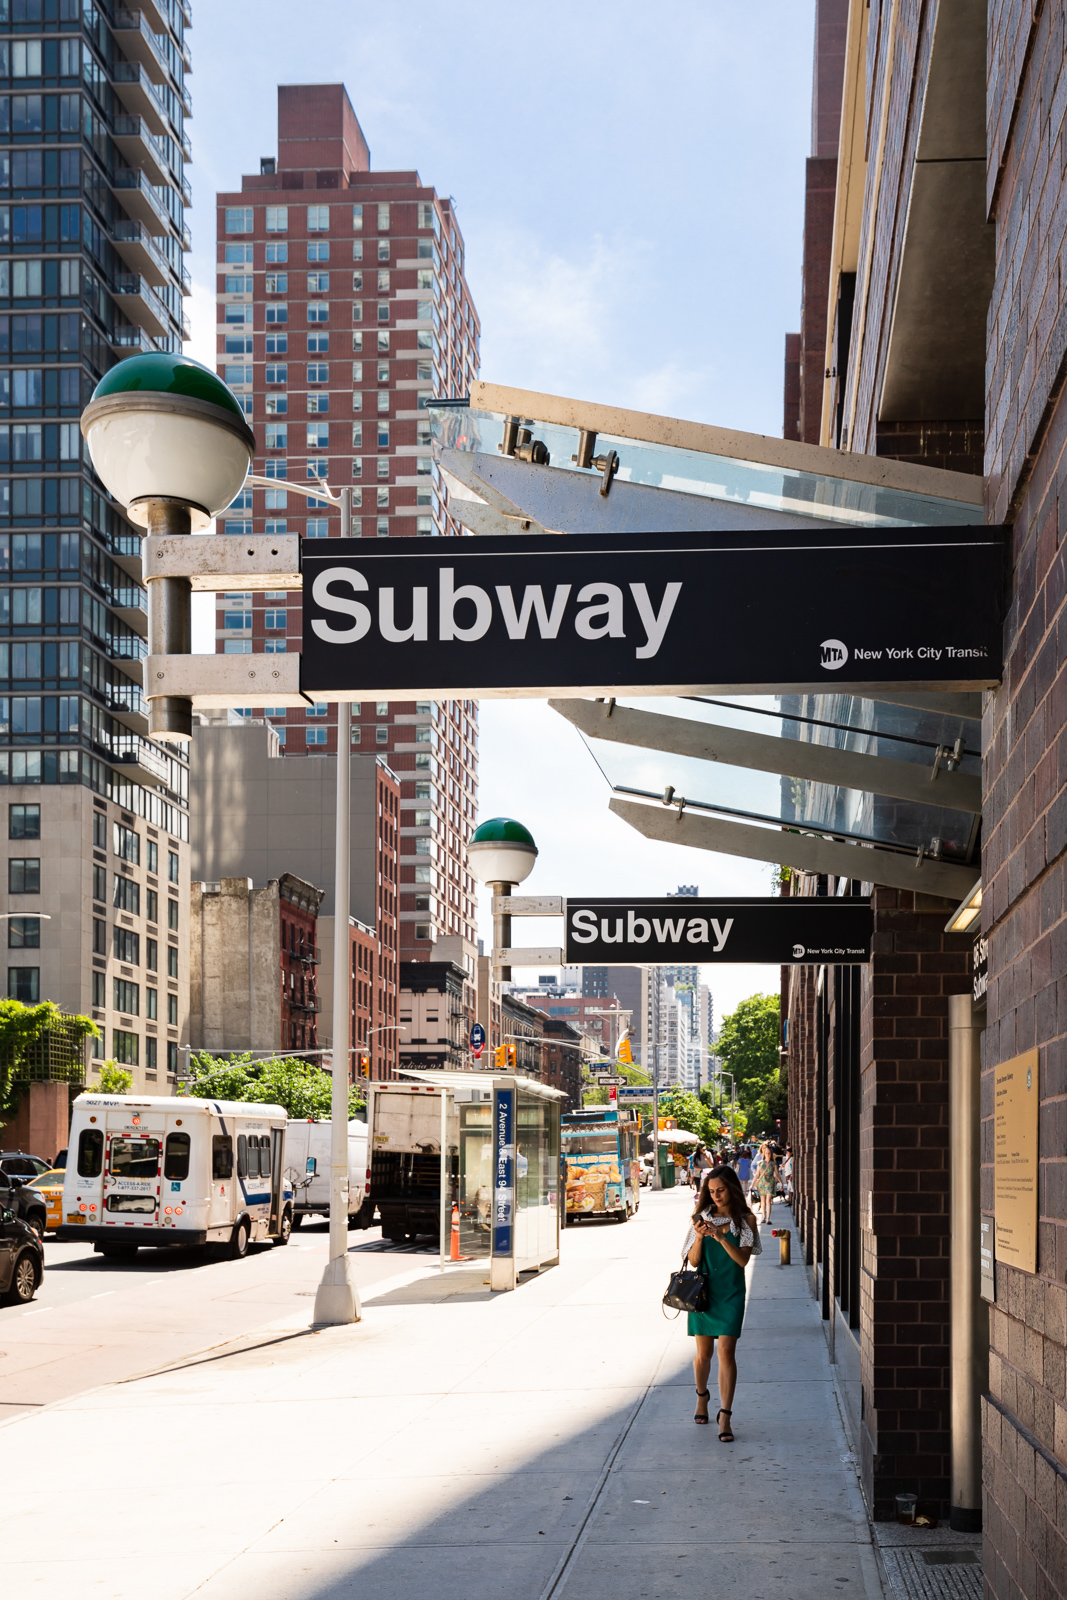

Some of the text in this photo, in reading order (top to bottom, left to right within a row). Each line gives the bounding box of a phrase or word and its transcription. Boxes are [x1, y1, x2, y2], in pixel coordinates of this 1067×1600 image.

[311, 567, 683, 659] Subway
[854, 648, 882, 660] New
[886, 647, 914, 659] York
[917, 646, 942, 660] City
[945, 645, 988, 657] Transit
[571, 909, 734, 952] Subway
[499, 1111, 507, 1146] Avenue
[498, 1158, 507, 1179] East
[583, 1155, 598, 1163] FOOD
[599, 1154, 618, 1162] HOUSE
[498, 1180, 507, 1192] 94
[497, 1194, 506, 1222] Street
